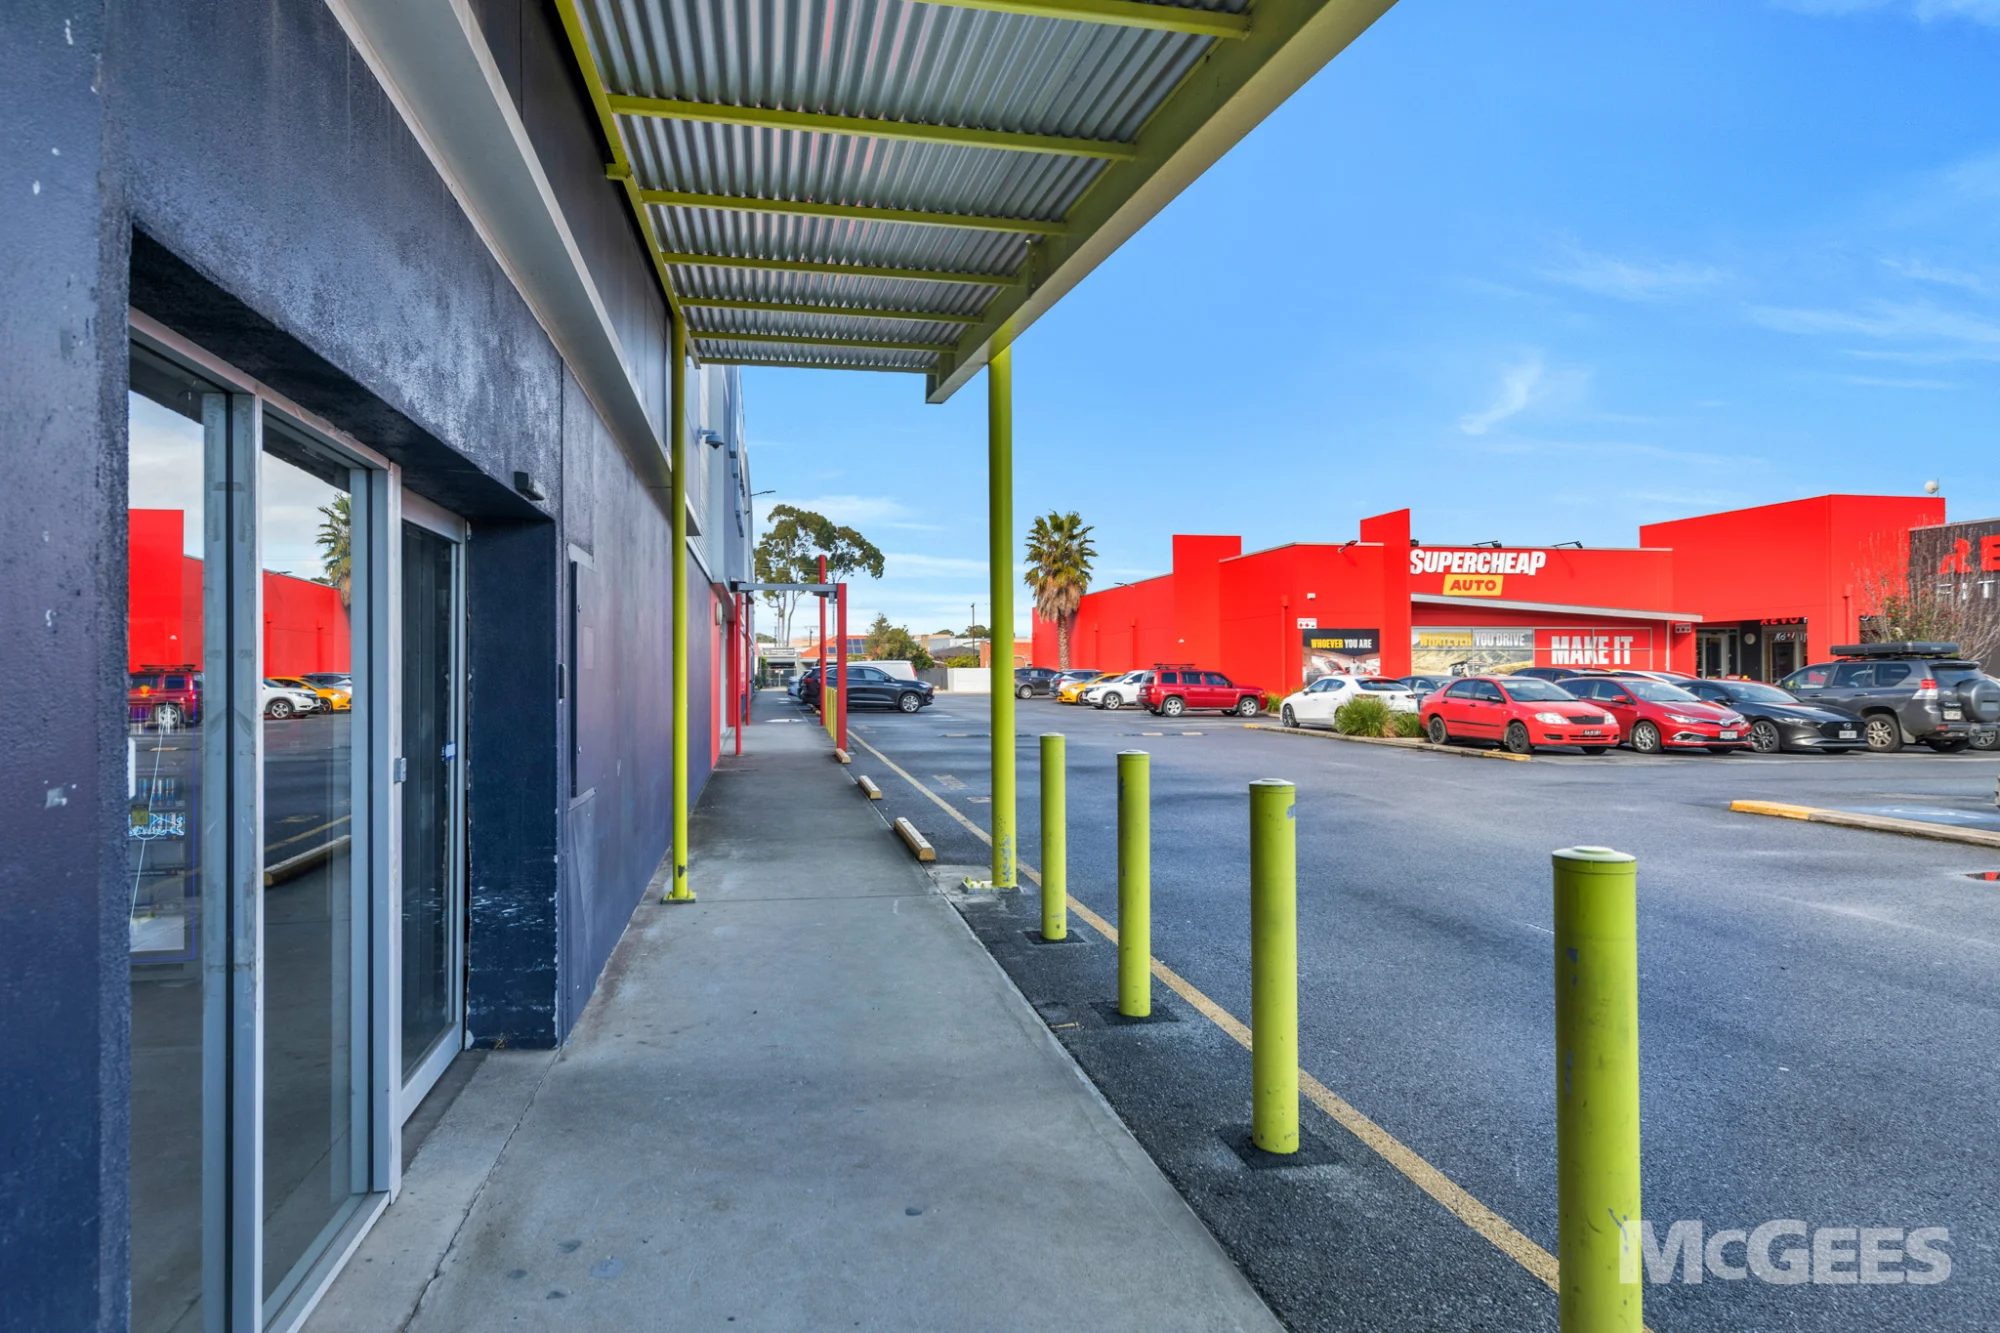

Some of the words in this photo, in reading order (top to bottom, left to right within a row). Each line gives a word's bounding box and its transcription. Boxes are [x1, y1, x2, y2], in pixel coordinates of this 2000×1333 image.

[1410, 549, 1546, 576] SUPERCHEAP
[1450, 580, 1497, 591] AUTO
[1311, 638, 1343, 649] WHOEVER
[1344, 638, 1358, 649] YOU
[1359, 638, 1372, 649] ARE
[1419, 632, 1472, 647] WHATEVER
[1475, 632, 1495, 647] YOU
[1496, 632, 1525, 647] DRIVE
[1551, 636, 1609, 665] MAKE
[1613, 636, 1633, 665] IT
